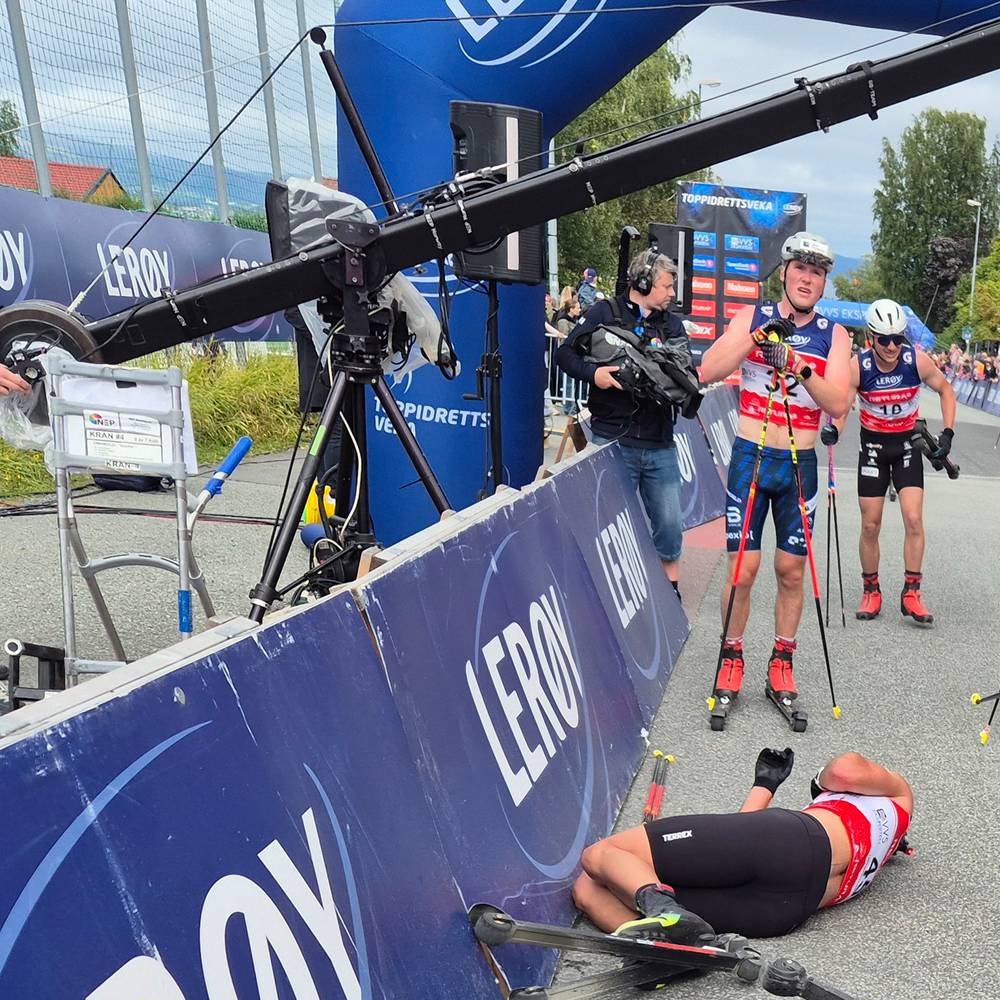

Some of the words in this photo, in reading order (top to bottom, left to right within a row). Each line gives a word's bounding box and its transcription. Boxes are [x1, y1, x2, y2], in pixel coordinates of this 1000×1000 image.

[681, 193, 773, 211] TOPPIDRETTSVEKA
[96, 242, 172, 299] LERØY
[875, 374, 902, 385] LERØY
[374, 395, 491, 428] TPPIDRETTS
[89, 431, 114, 441] KRAN
[374, 415, 416, 438] VEA
[598, 508, 648, 629] LERØY
[465, 585, 583, 807] LERØY
[662, 829, 692, 842] TERREX
